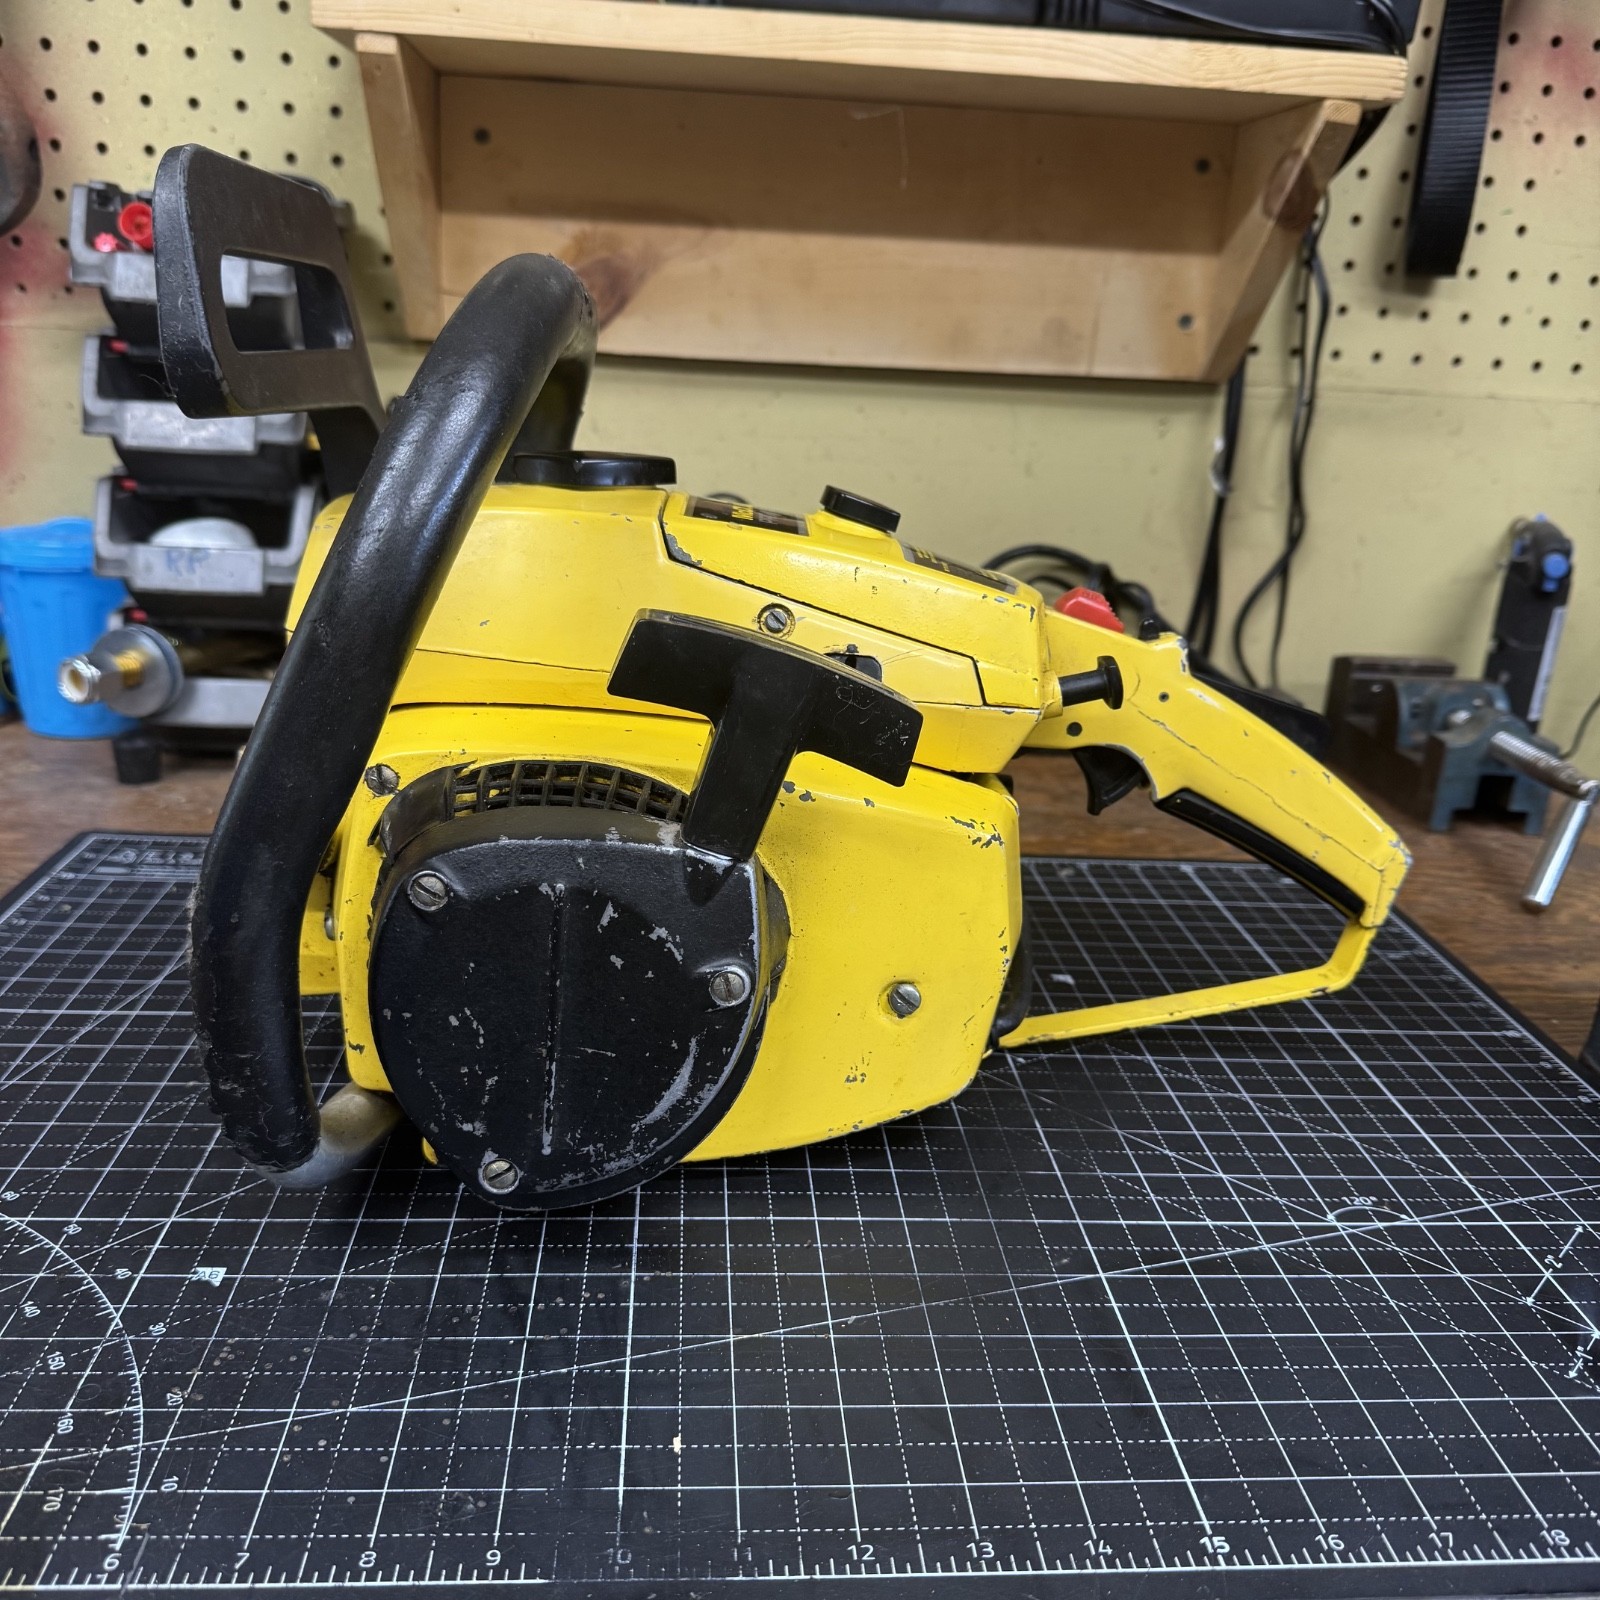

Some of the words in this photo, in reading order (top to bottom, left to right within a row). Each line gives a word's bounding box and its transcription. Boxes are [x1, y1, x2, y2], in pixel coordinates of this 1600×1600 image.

[1, 1190, 20, 1201] 60
[63, 1223, 82, 1235] 50
[114, 1268, 132, 1279] 40
[198, 1270, 220, 1280] A6
[20, 1301, 40, 1317] 140
[149, 1322, 167, 1336] 30
[47, 1351, 66, 1370] 150
[166, 1392, 183, 1406] 20
[57, 1412, 74, 1434] 160
[161, 1475, 179, 1492] 10
[42, 1487, 65, 1512] 170
[1199, 1536, 1231, 1554] 15
[1314, 1534, 1345, 1552] 16
[1428, 1531, 1455, 1549] 17
[1540, 1529, 1571, 1547] 18
[607, 1548, 632, 1564] 10
[732, 1547, 752, 1561] 11
[847, 1544, 876, 1561] 12
[966, 1542, 995, 1558] 13
[1083, 1539, 1113, 1557] 14
[103, 1553, 122, 1571] 6
[234, 1552, 250, 1570] 7
[358, 1551, 377, 1568] 8
[485, 1549, 502, 1566] 9
